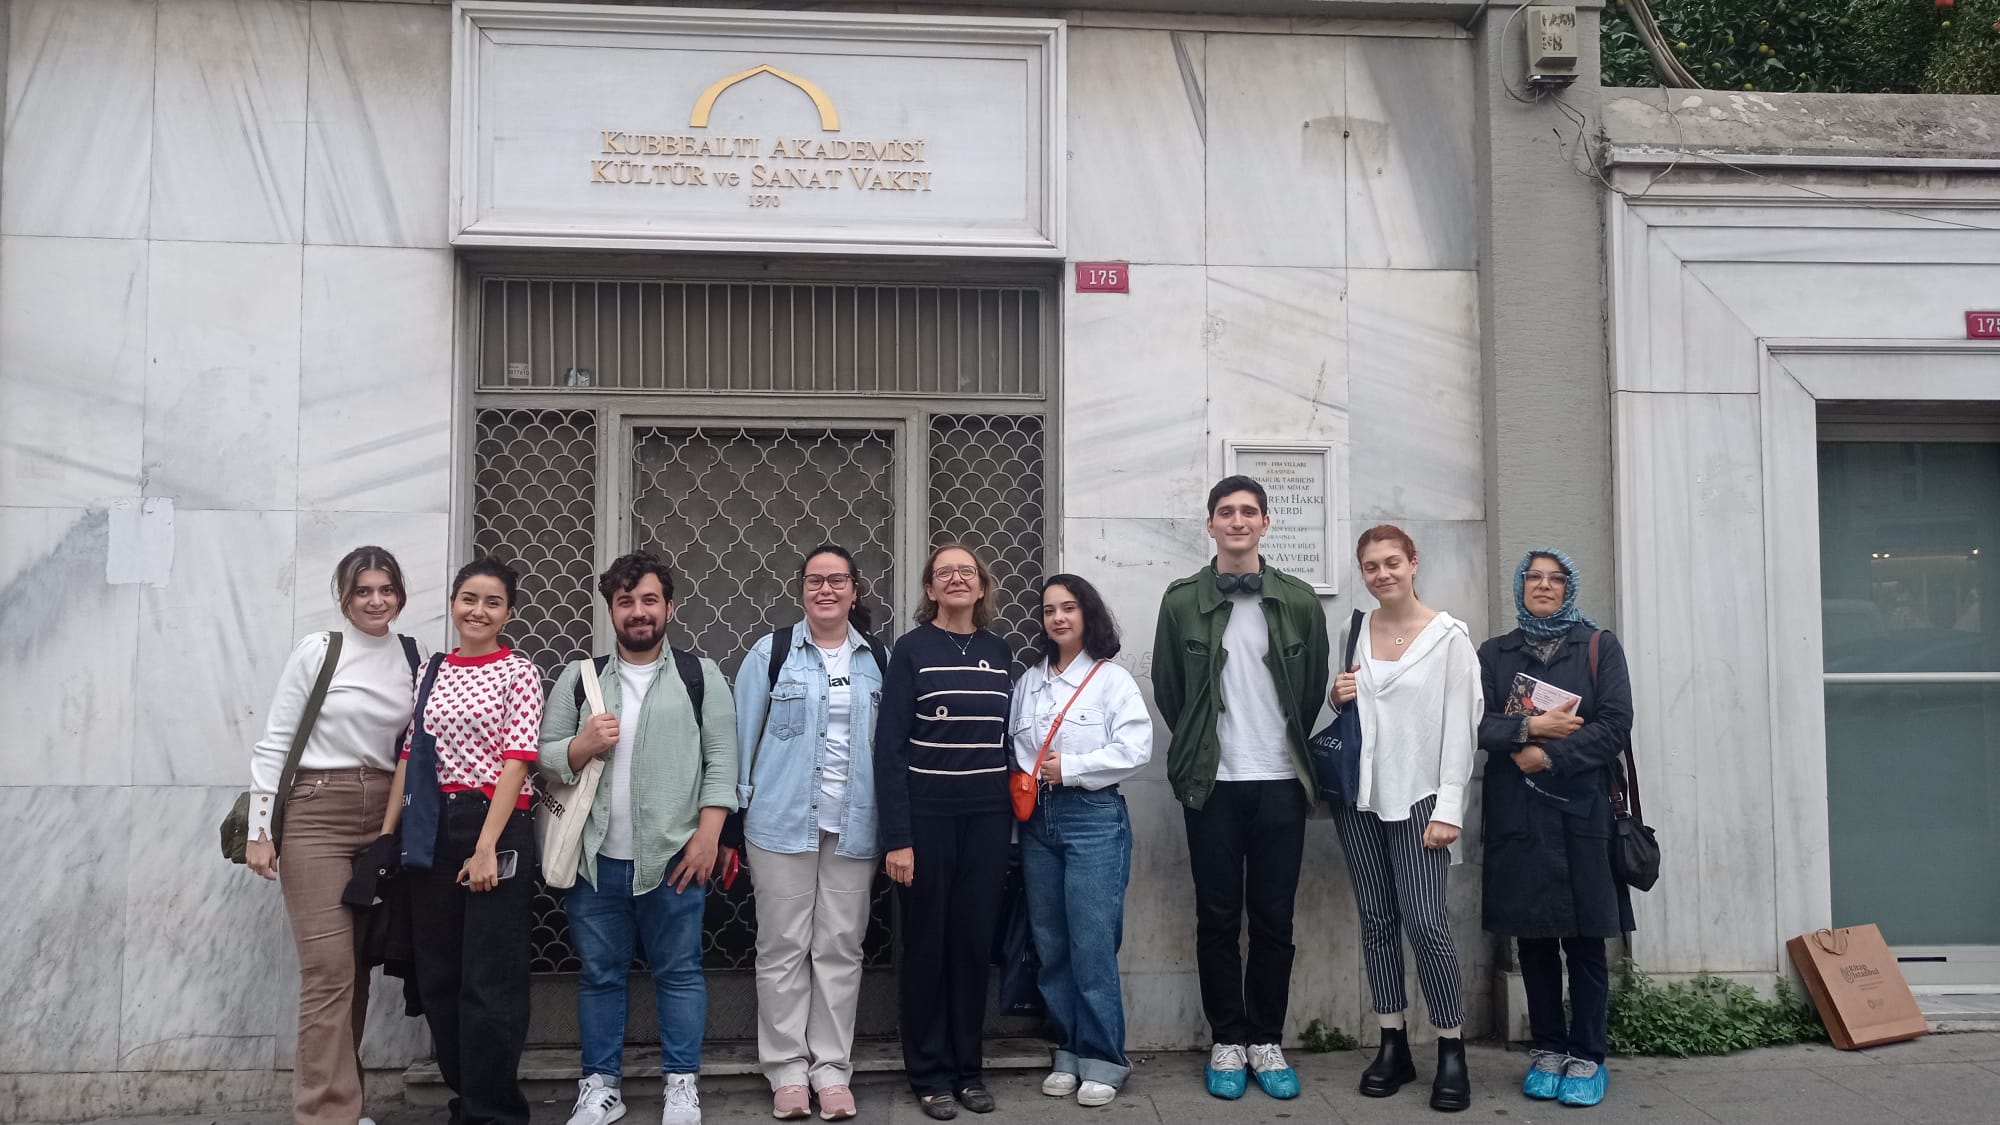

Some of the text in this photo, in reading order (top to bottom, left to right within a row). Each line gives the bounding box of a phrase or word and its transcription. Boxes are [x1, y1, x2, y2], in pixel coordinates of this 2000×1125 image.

[600, 130, 926, 163] KUBBEALTI AKADEMİSİ
[590, 159, 933, 192] KÜLTÜR ve SANAT VAKFI
[748, 193, 781, 208] 1970
[1089, 270, 1118, 286] 175
[1268, 494, 1324, 504] REM HAKKI
[1267, 506, 1303, 515] YVERDİ
[1276, 552, 1320, 562] AYVERDİ
